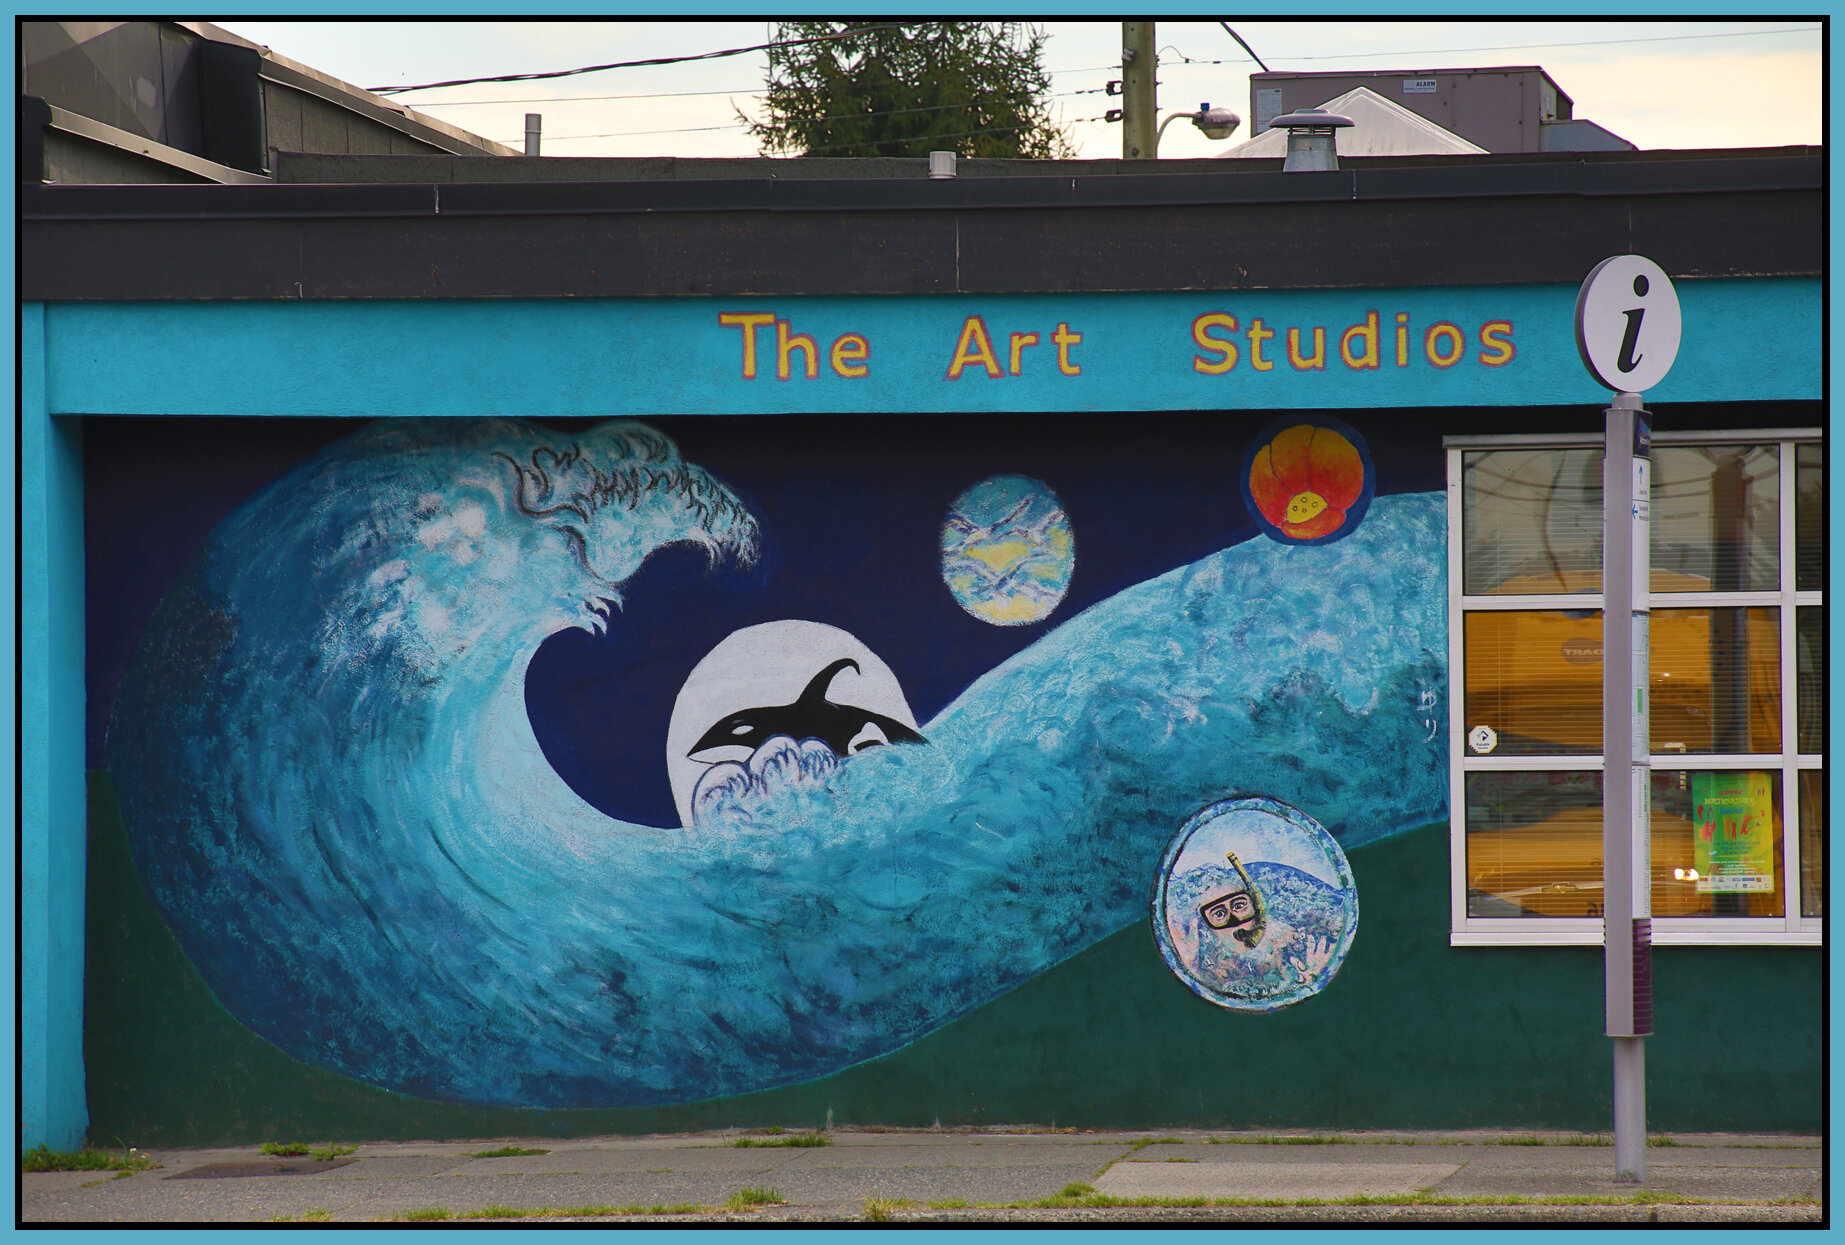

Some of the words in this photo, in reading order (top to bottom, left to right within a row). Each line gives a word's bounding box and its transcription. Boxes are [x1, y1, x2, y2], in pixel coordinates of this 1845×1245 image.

[718, 311, 872, 381] The
[943, 315, 1083, 381] Art
[1191, 310, 1518, 375] Studios
[1617, 274, 1650, 373] i
